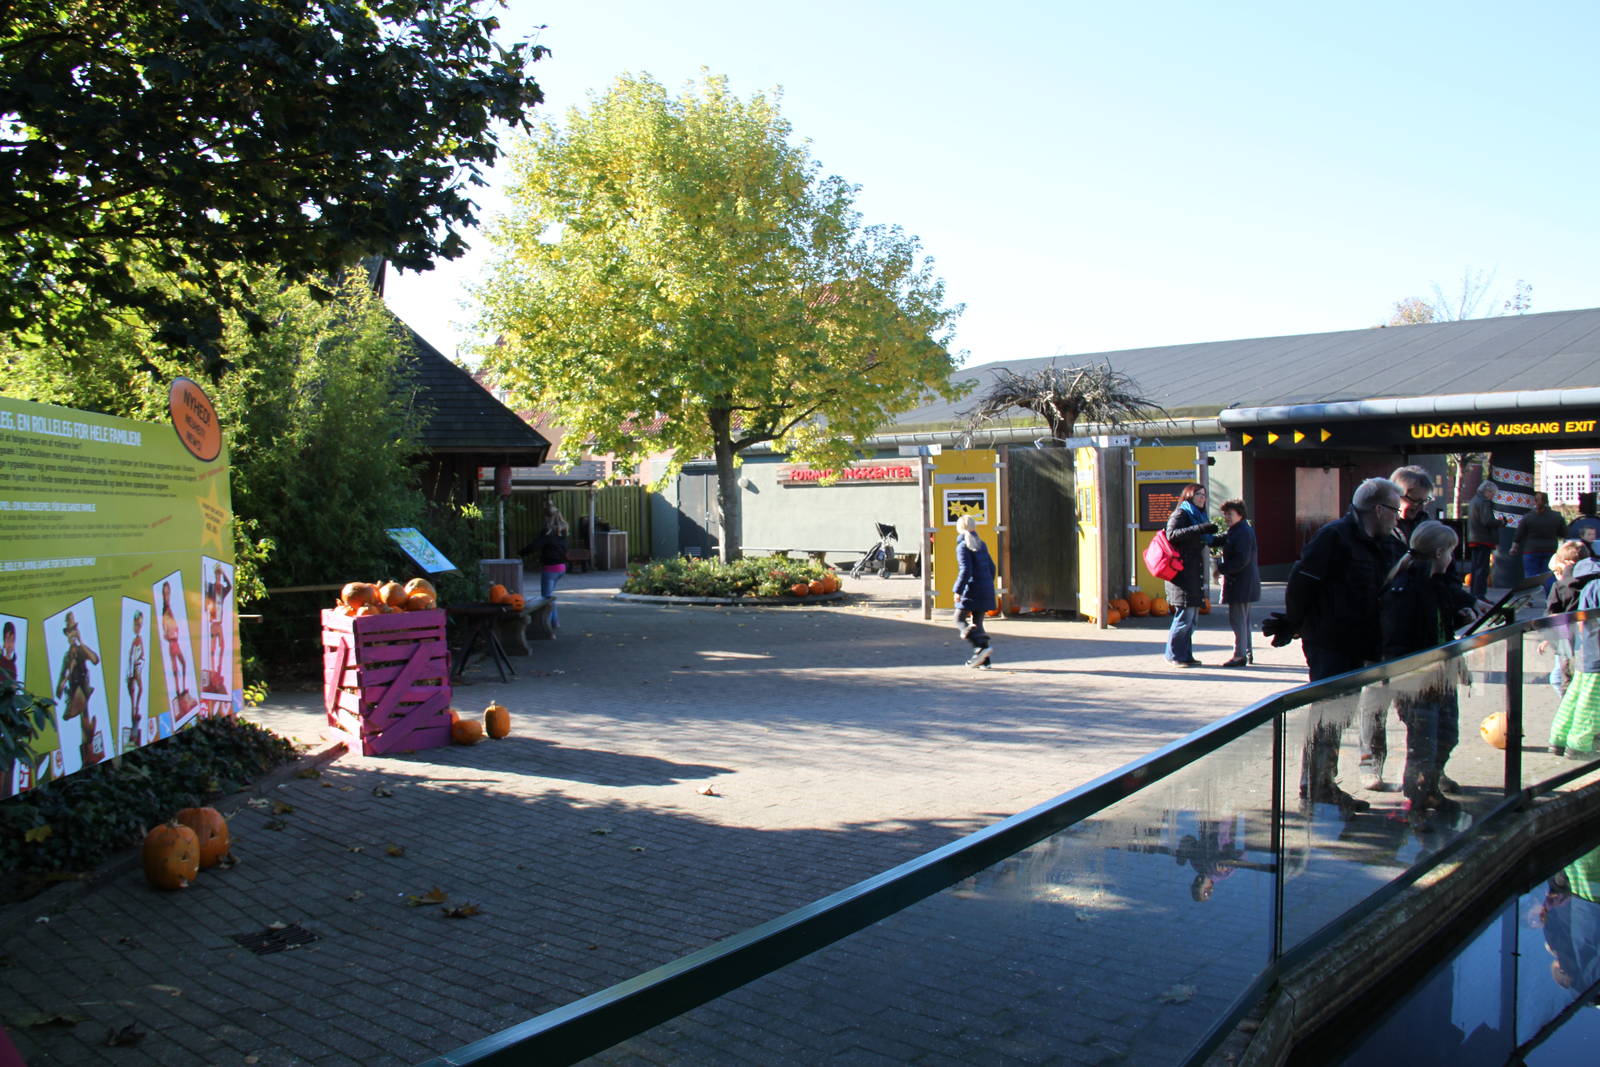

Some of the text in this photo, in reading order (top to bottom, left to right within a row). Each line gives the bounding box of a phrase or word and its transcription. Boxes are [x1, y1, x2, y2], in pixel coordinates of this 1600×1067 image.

[1410, 420, 1597, 438] UDGANG AUSGANG EXIT
